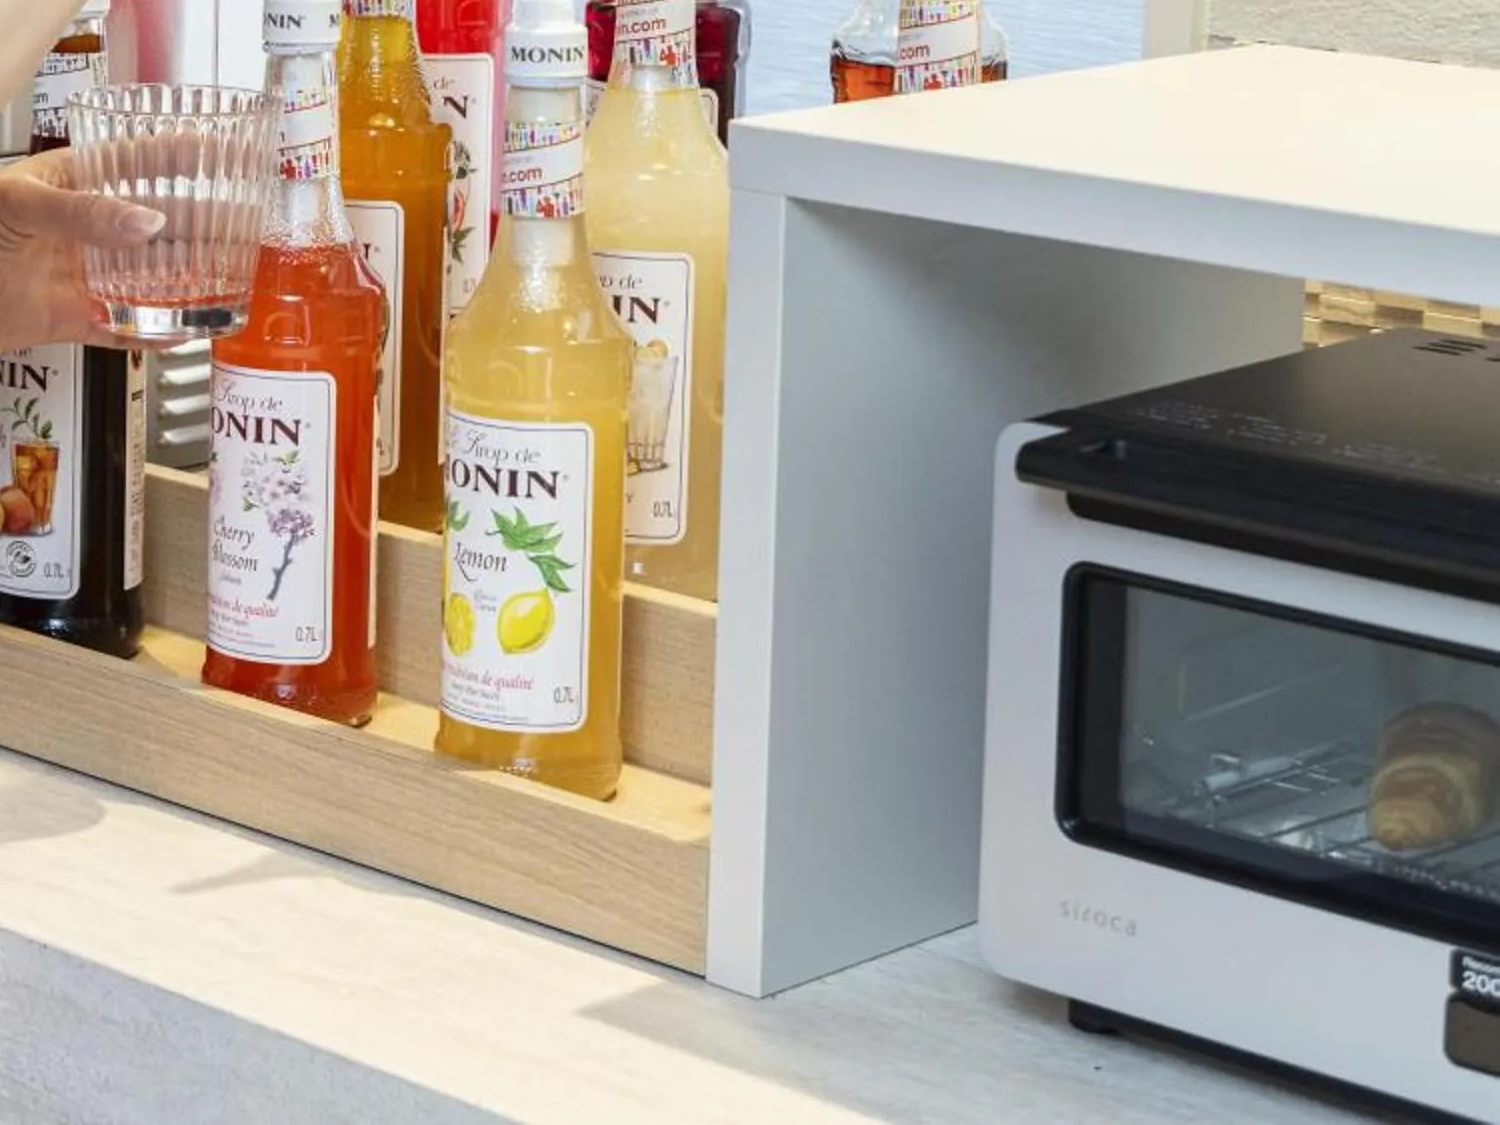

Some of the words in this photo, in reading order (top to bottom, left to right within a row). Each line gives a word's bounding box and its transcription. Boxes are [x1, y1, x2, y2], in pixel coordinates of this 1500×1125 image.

[510, 46, 586, 64] MONIN
[446, 455, 561, 501] ONIN
[453, 541, 508, 583] Lemon
[1059, 897, 1138, 936] siroca
